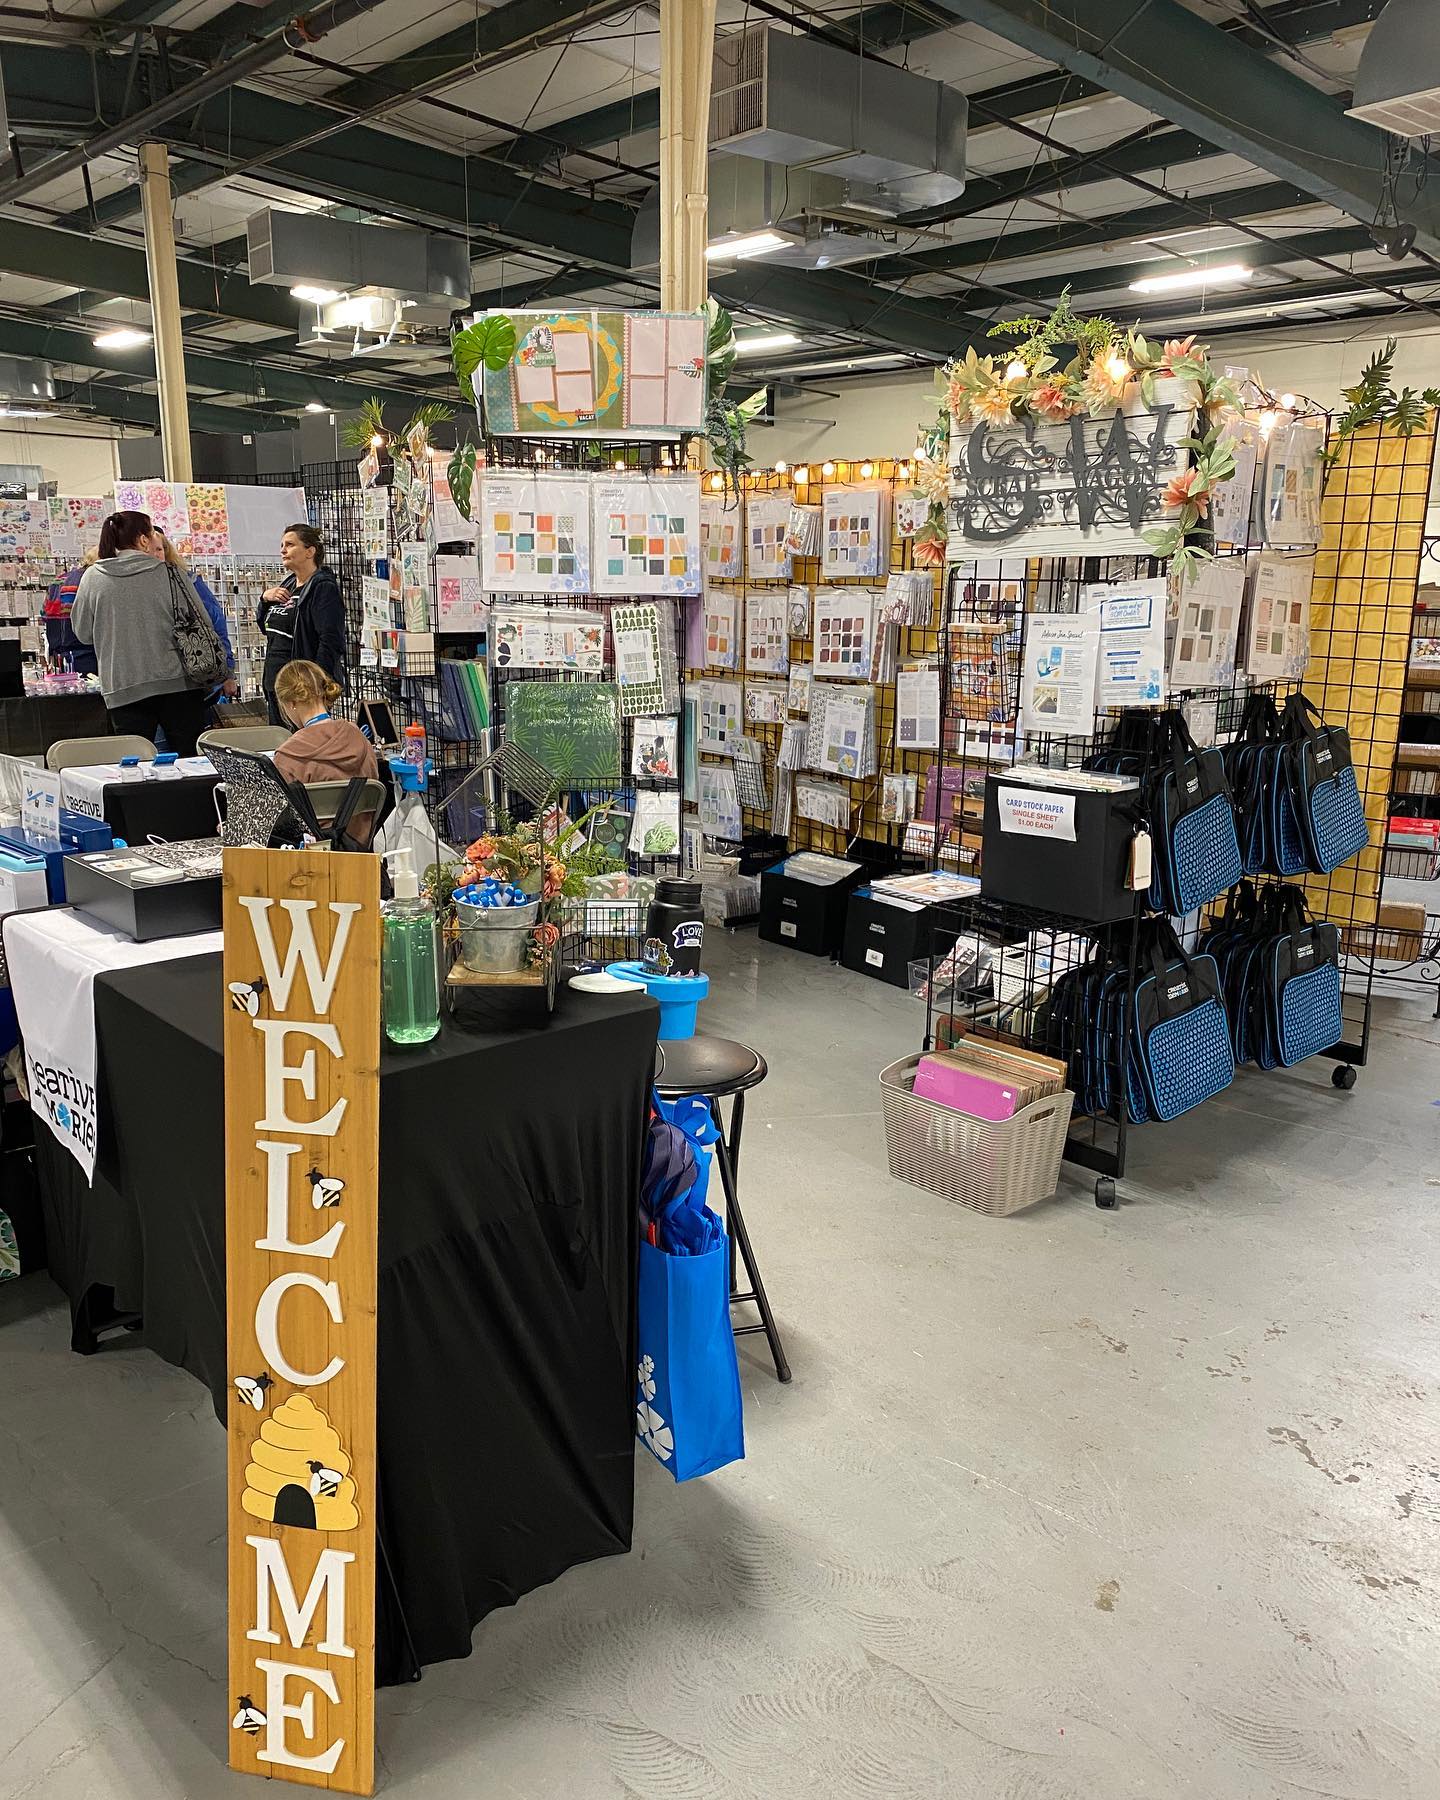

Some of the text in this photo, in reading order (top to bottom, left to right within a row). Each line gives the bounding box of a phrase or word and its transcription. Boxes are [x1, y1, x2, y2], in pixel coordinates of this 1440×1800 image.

[965, 467, 1157, 497] SCRAP WAGON
[1006, 799, 1064, 814] CARD STOCK PAPER
[1012, 809, 1059, 822] SINGLE SHEET
[1018, 818, 1054, 830] $1.00 EACH
[238, 895, 363, 1774] WELCME
